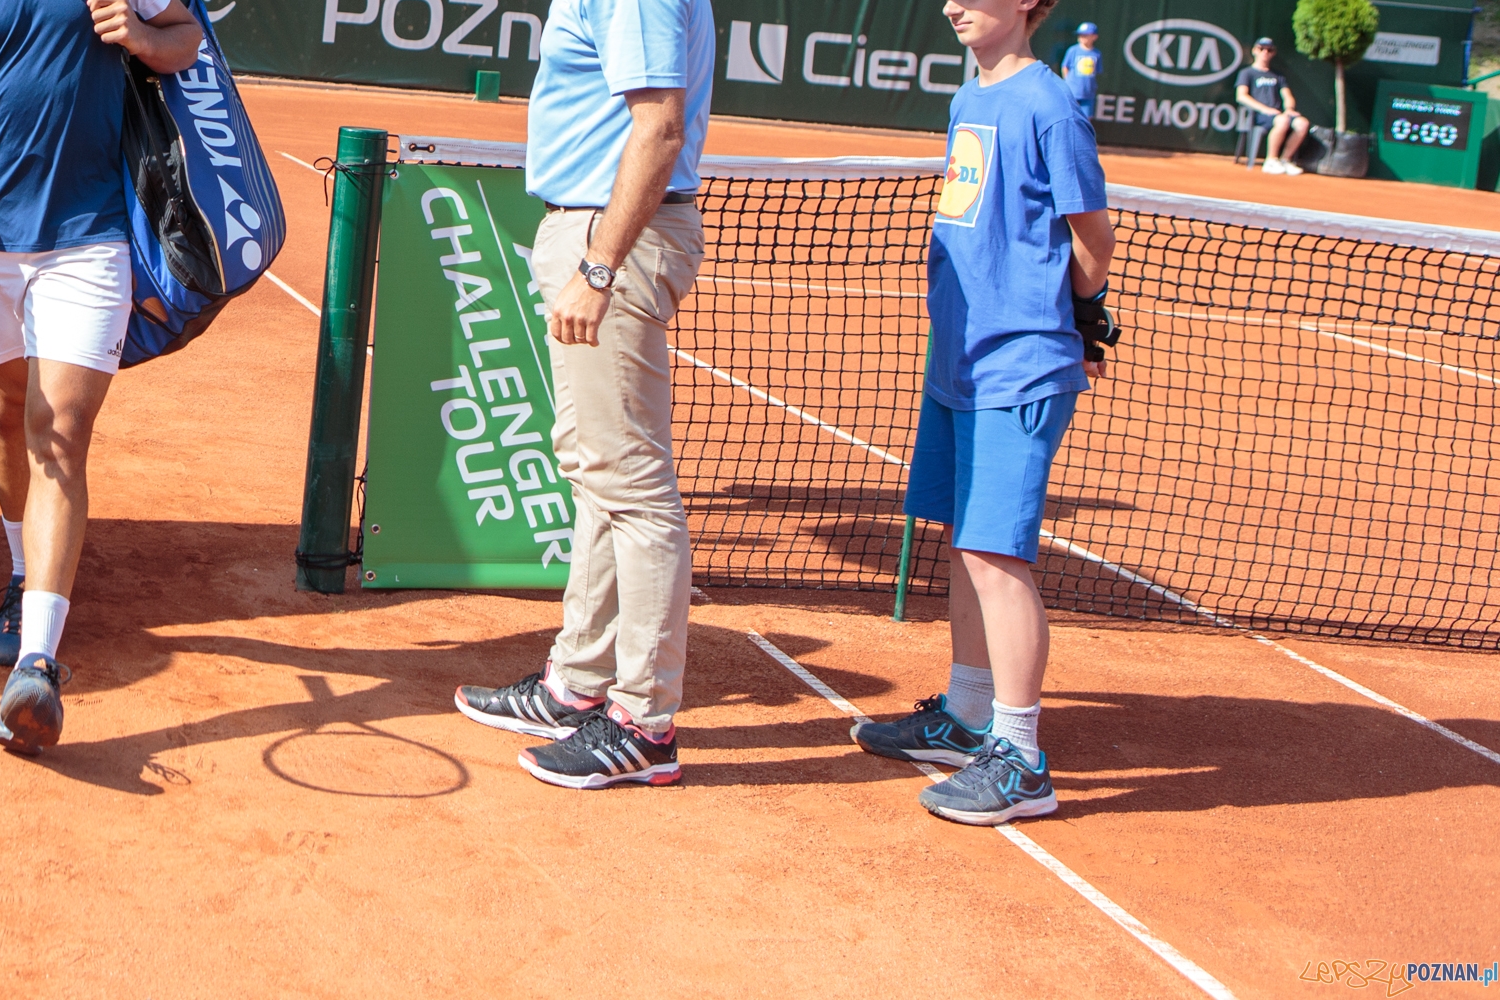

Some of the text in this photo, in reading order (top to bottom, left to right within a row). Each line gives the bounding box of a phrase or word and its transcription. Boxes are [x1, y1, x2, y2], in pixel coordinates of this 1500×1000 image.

[1145, 33, 1222, 71] KIA
[1391, 118, 1458, 146] 0:00
[420, 187, 574, 570] CHALLENGER
[430, 365, 515, 527] TOUR
